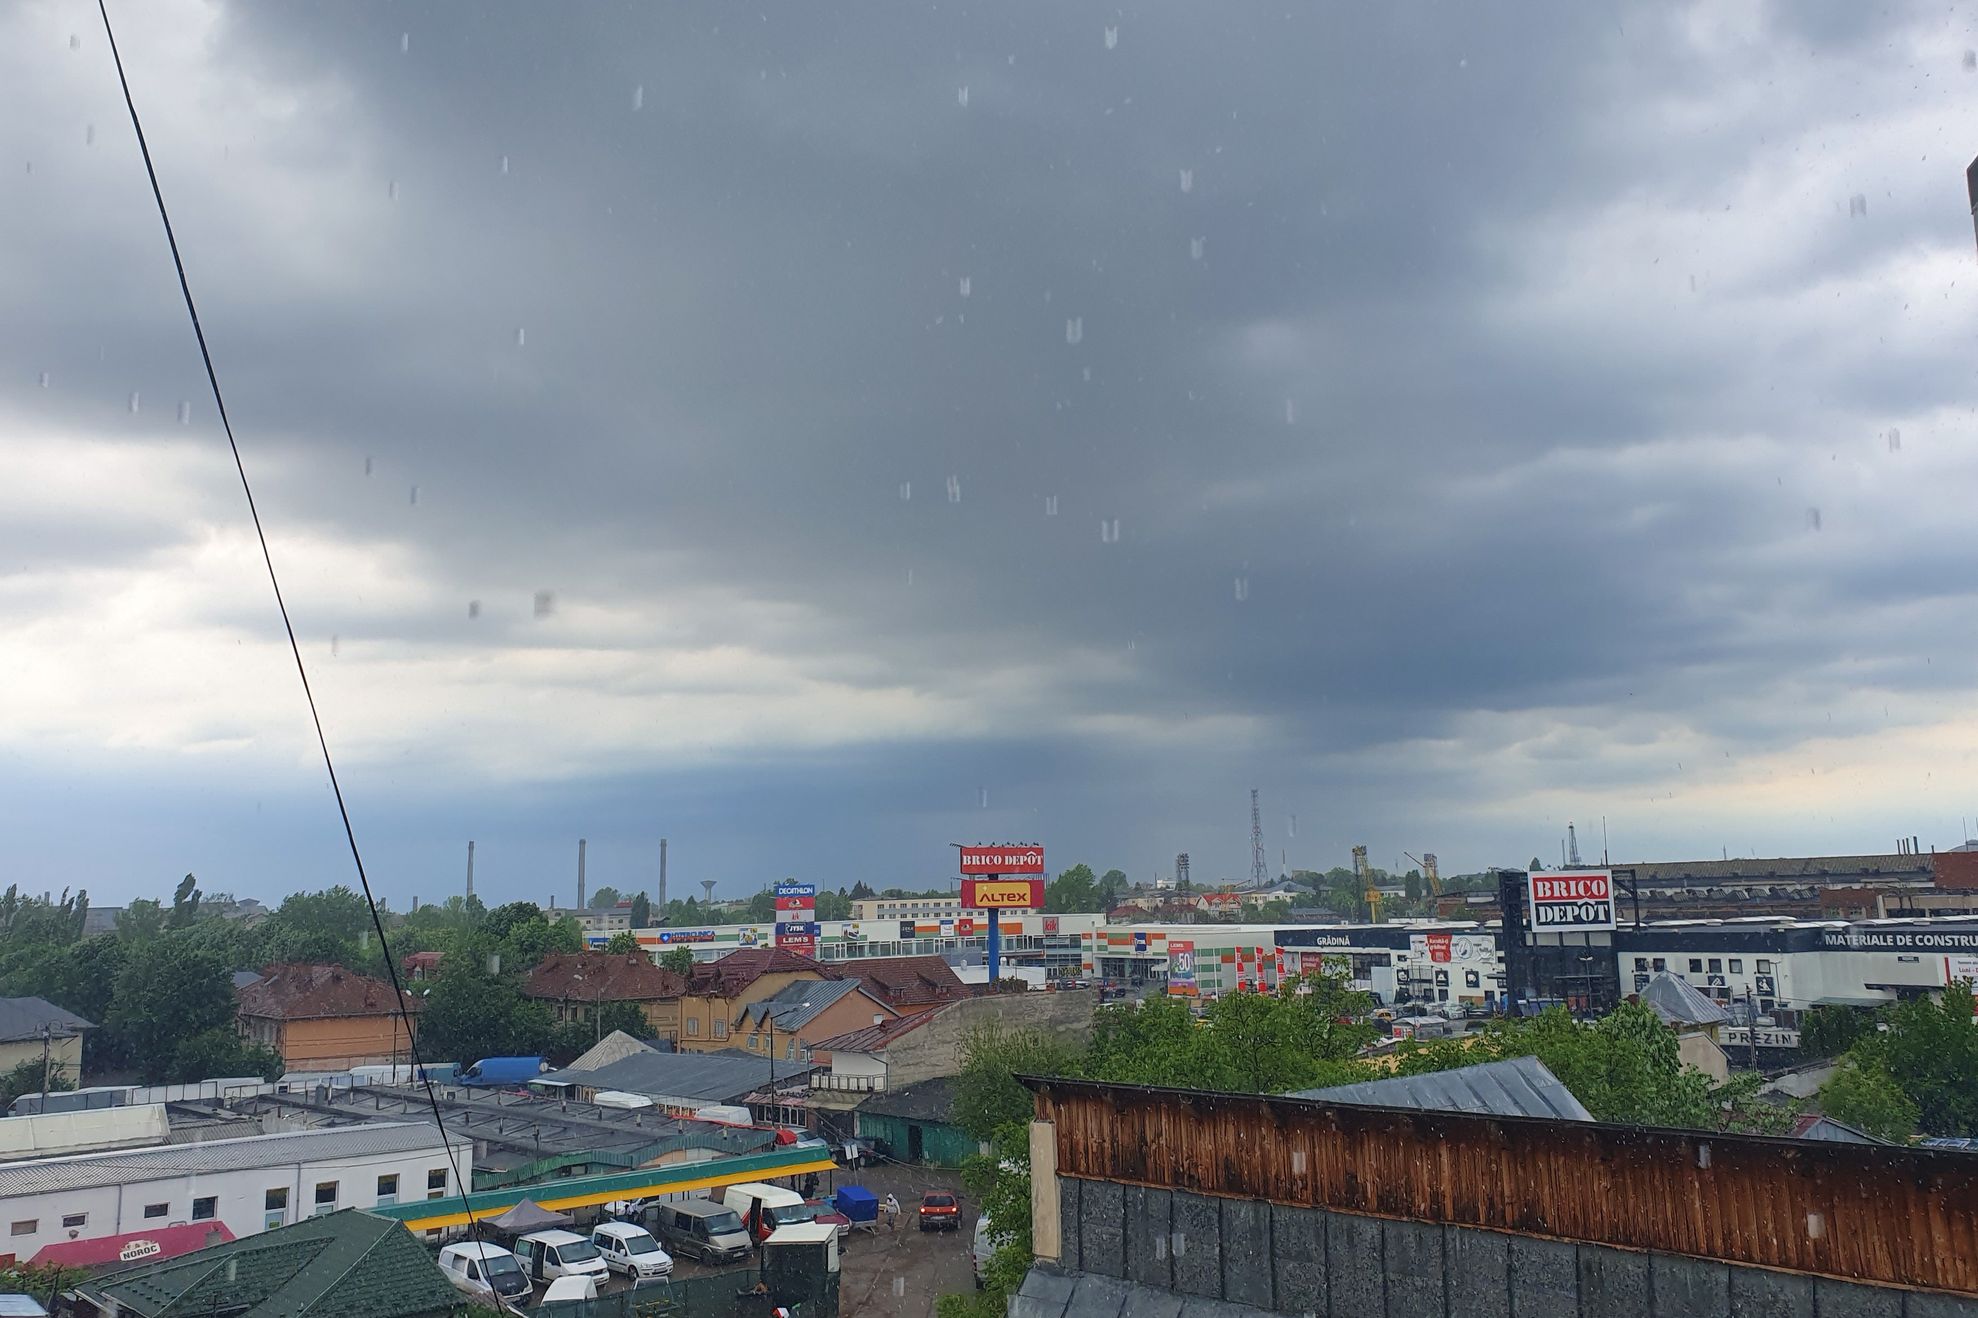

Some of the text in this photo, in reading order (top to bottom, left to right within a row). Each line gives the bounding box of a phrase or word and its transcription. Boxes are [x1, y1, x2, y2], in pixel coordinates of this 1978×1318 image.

[963, 851, 1043, 865] BRICO DEPÔT
[778, 887, 814, 895] DECATHLON
[1536, 879, 1606, 898] BRICO
[1537, 897, 1609, 922] DEPÔT
[1316, 934, 1351, 946] GRĂDINĂ
[1824, 934, 1894, 947] MATERIALE
[1896, 934, 1914, 947] DE
[122, 1245, 158, 1260] NOROC
